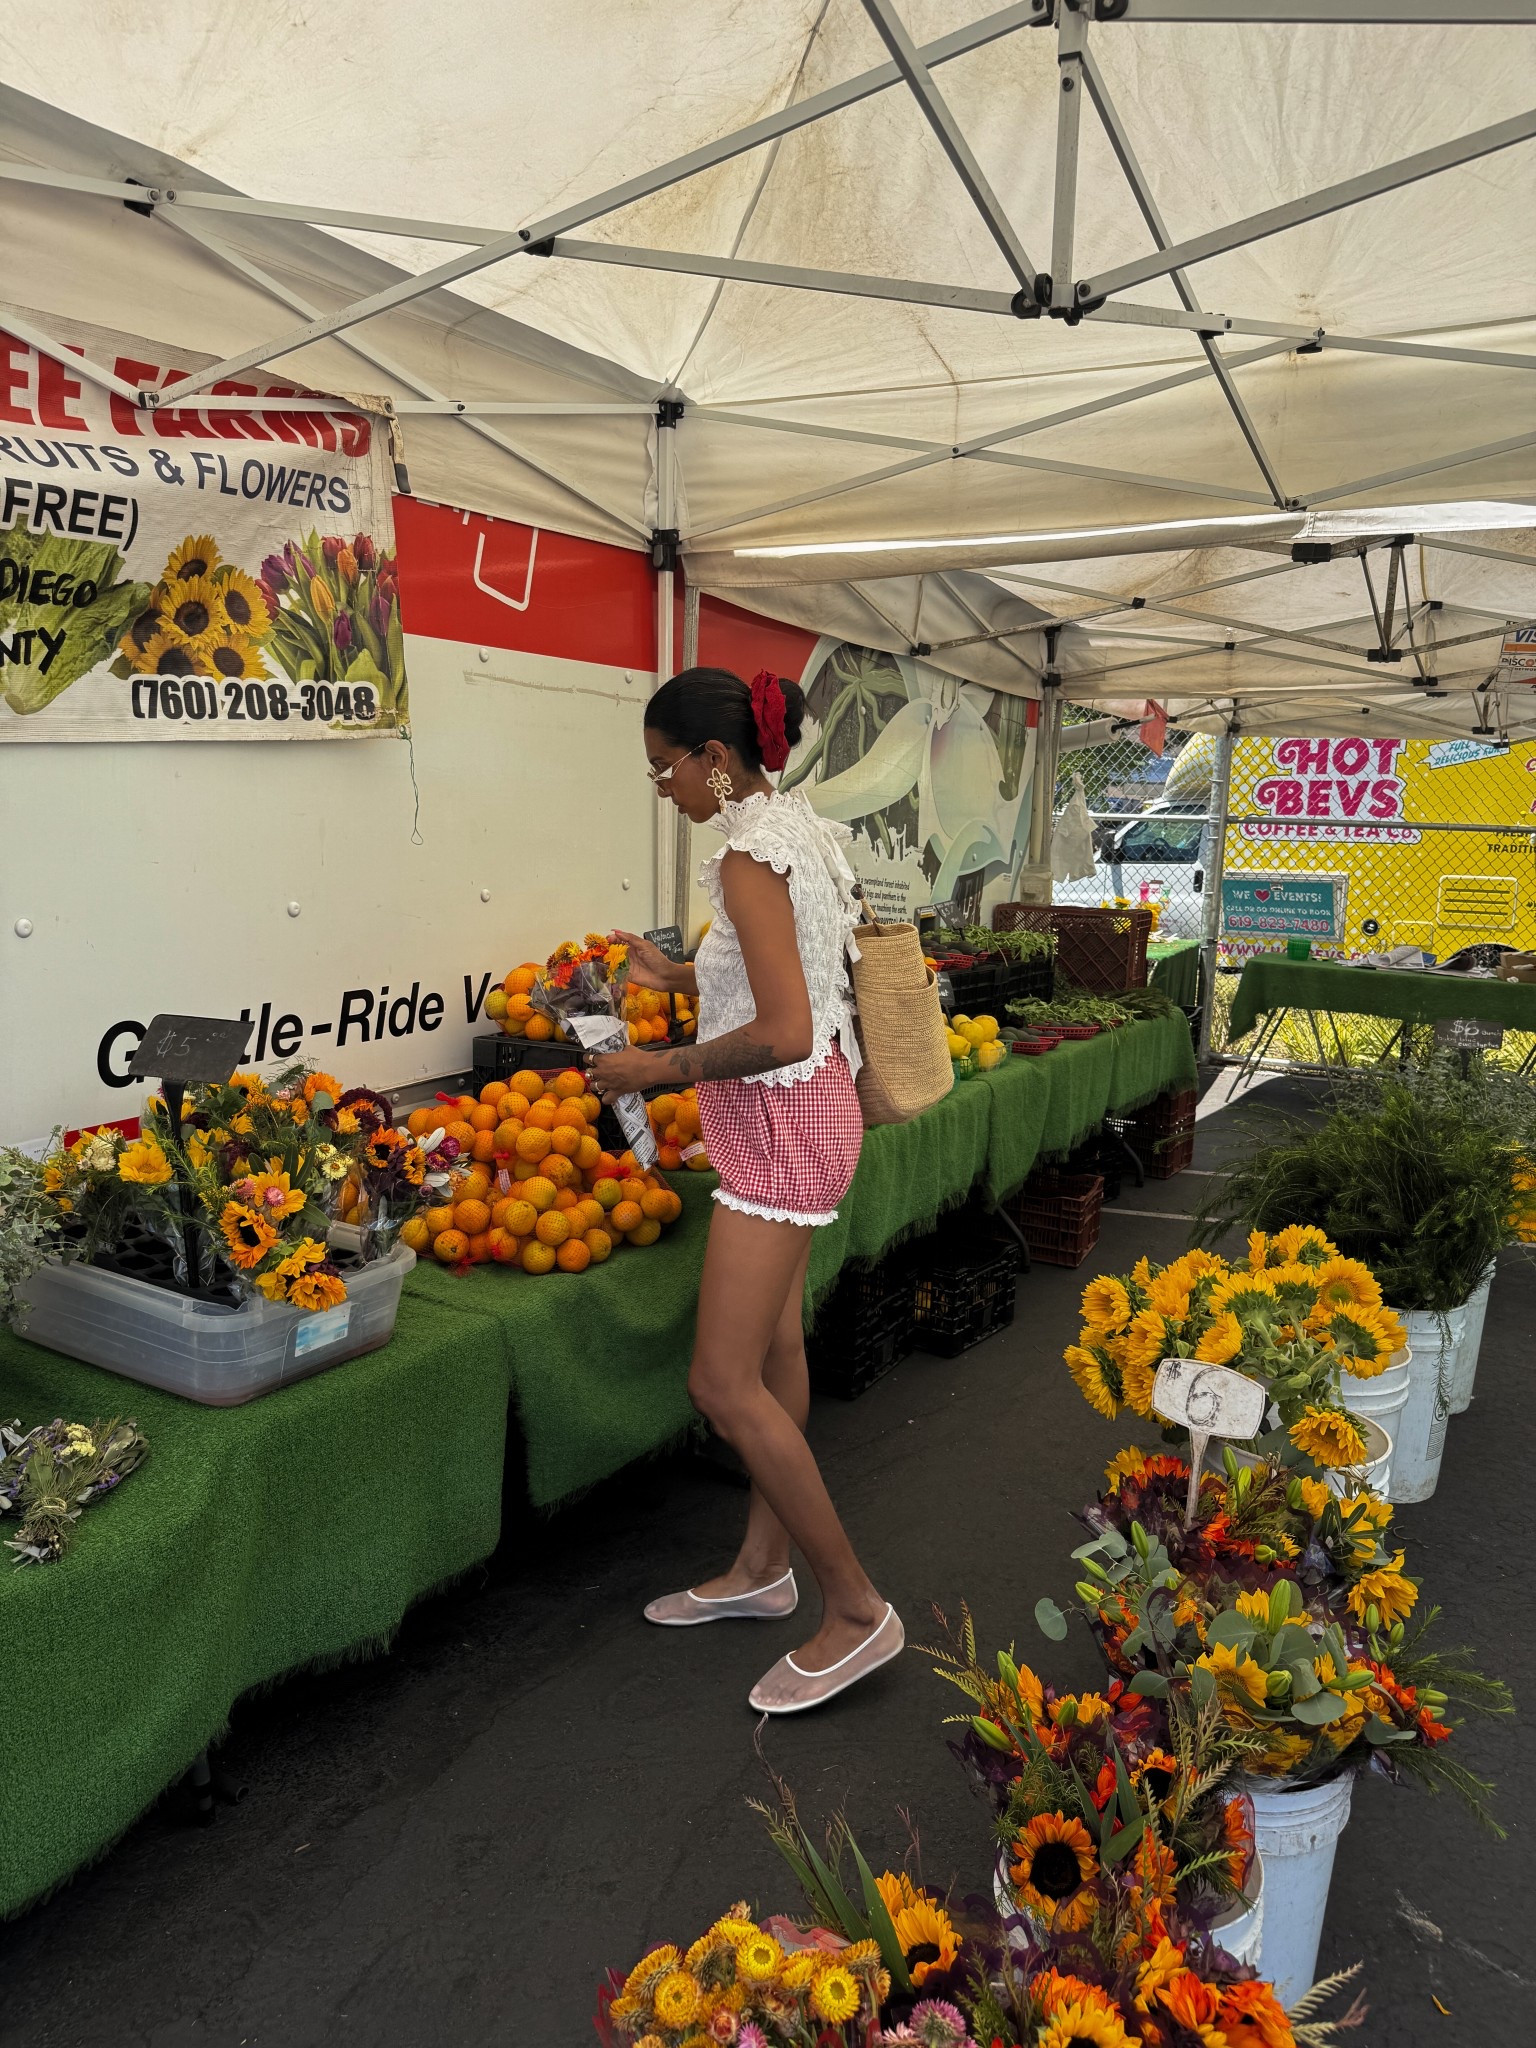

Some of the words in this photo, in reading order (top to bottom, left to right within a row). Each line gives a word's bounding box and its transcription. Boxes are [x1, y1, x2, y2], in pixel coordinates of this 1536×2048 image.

[110, 356, 372, 457] FARMS
[148, 448, 186, 486] &
[189, 451, 351, 514] FLOWERS
[2, 477, 139, 552] FREE)
[0, 557, 98, 608] DIEGO
[0, 626, 68, 676] NTY
[1501, 657, 1536, 668] DISCO
[131, 679, 219, 720] (760)
[223, 682, 376, 721] 208-3048
[1277, 738, 1401, 776] HOT
[1256, 779, 1401, 818] BEVS
[1244, 823, 1318, 836] COFFEE
[1325, 826, 1336, 835] &
[1344, 827, 1380, 838] TEA
[1487, 844, 1536, 853] TRADITI
[1232, 890, 1251, 900] WE
[1273, 891, 1322, 903] EVENTS!
[1228, 914, 1330, 932] 619-823-7480
[1450, 1019, 1480, 1038] $6
